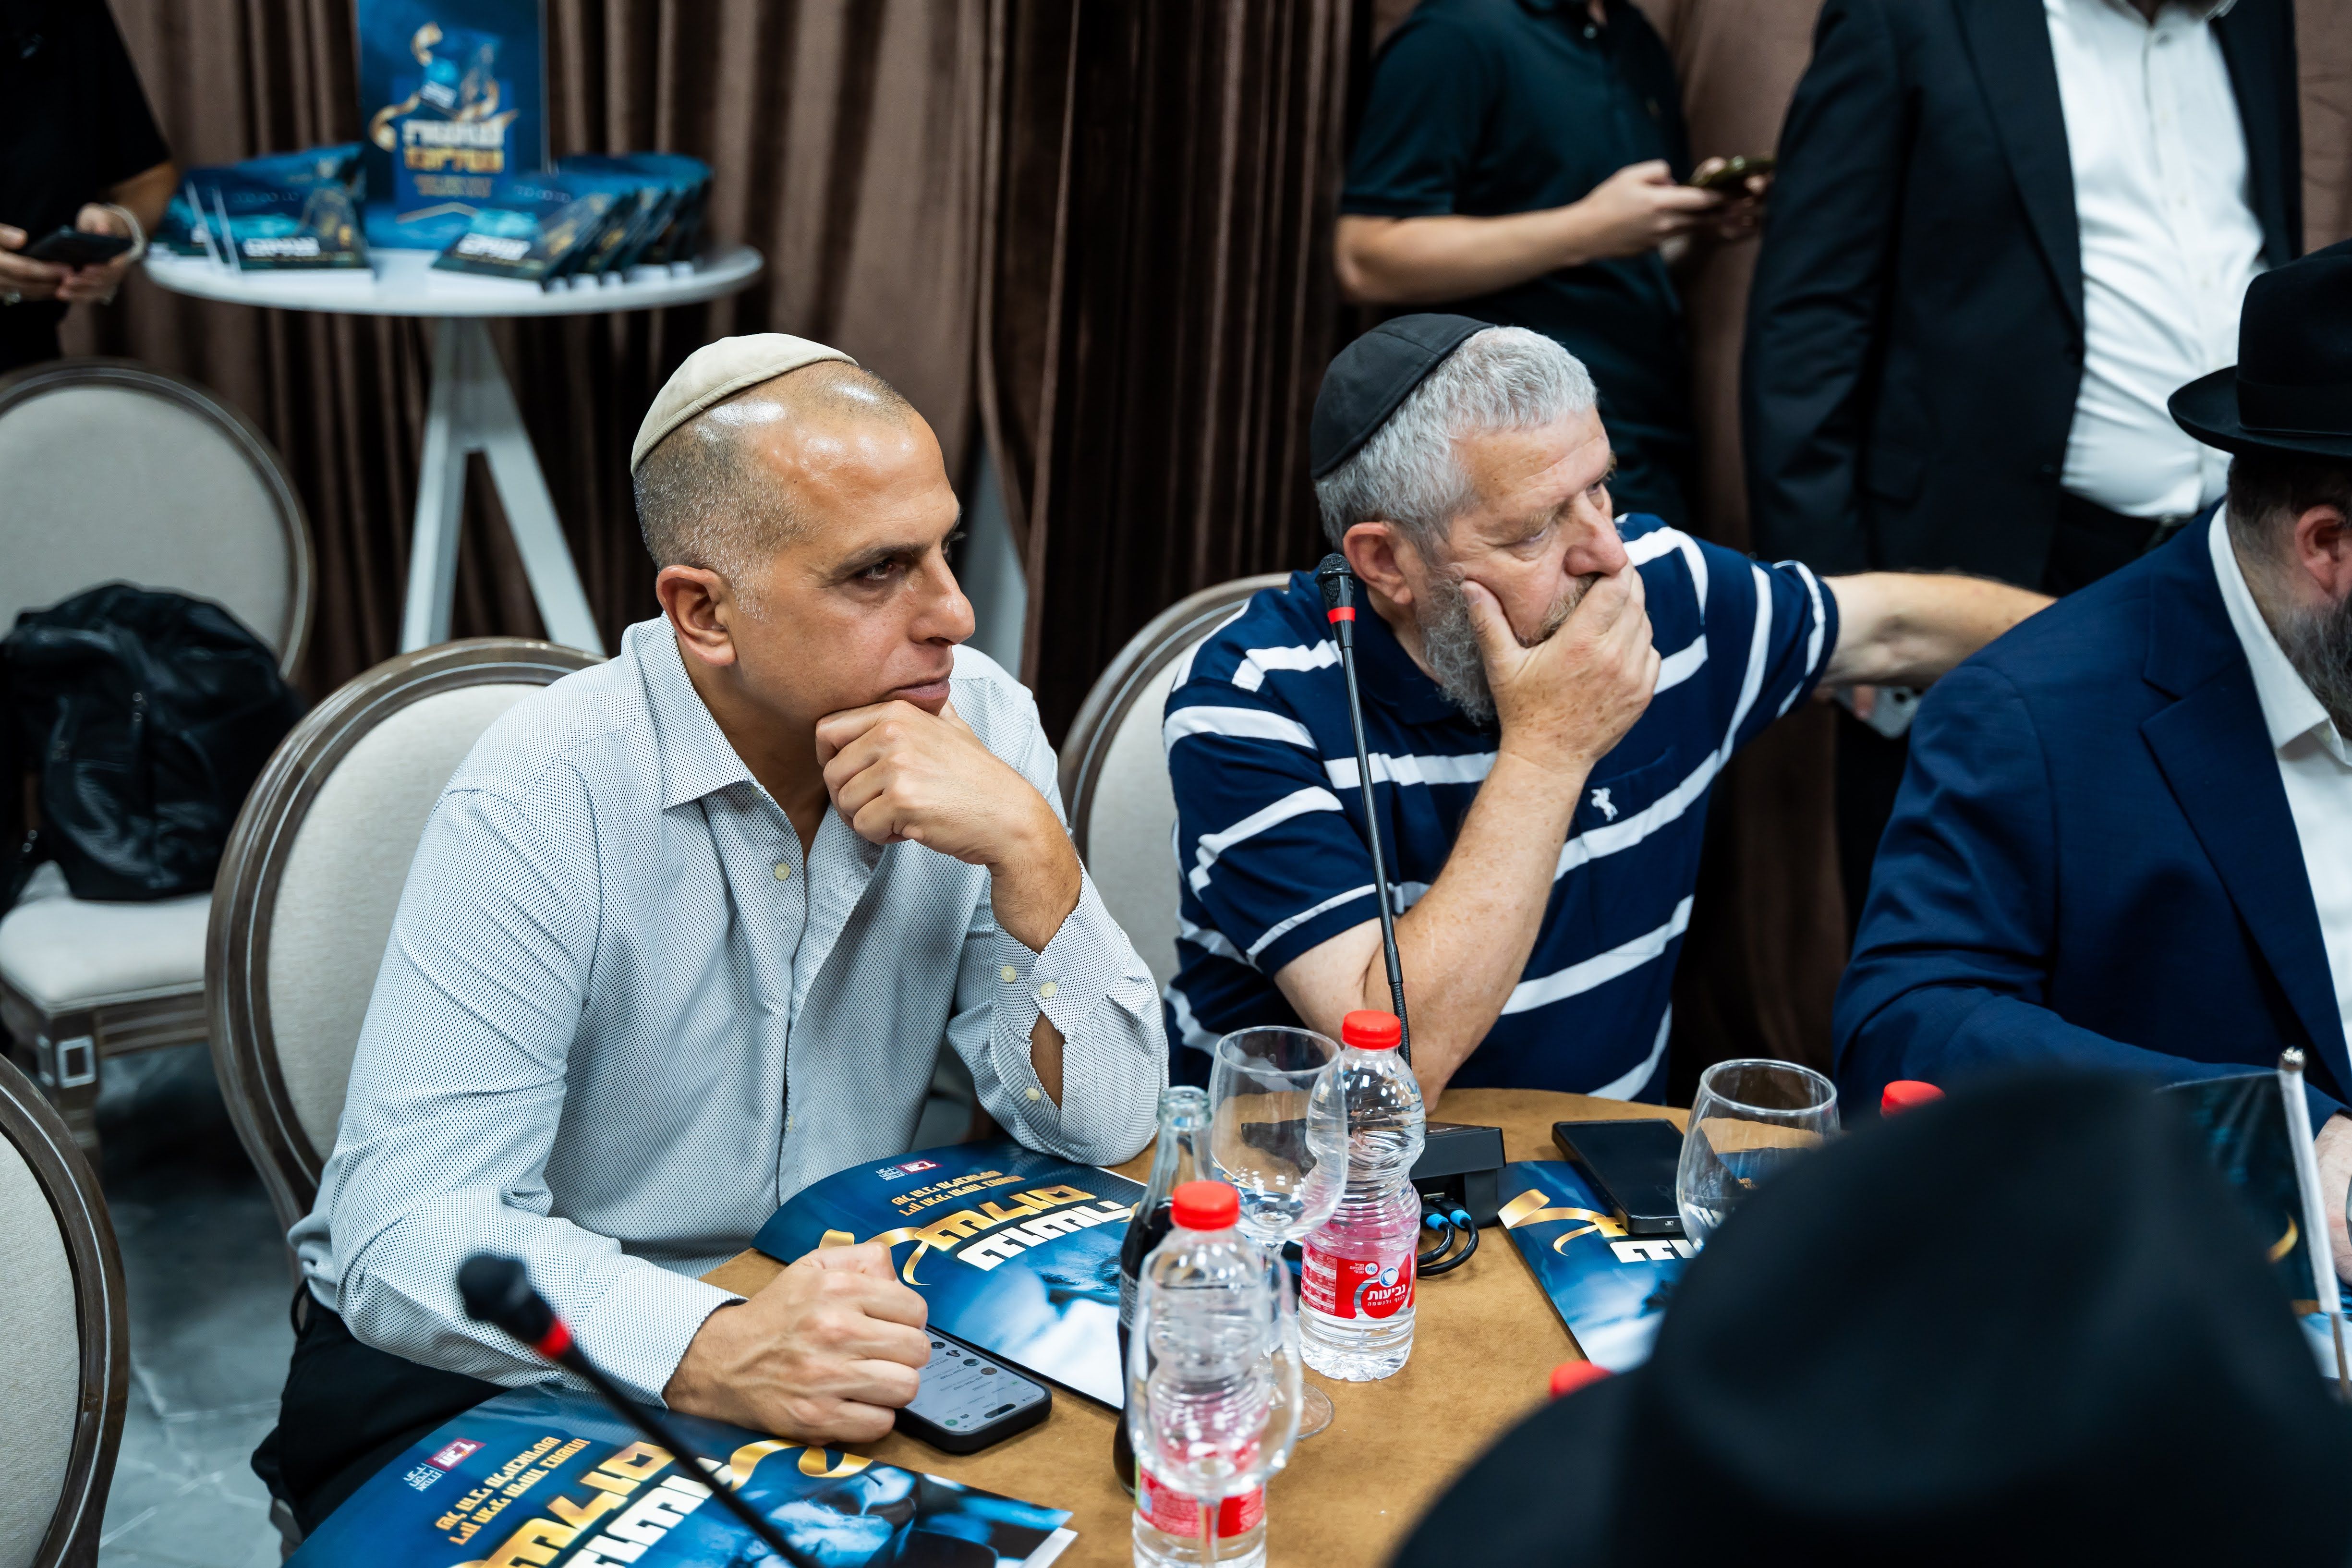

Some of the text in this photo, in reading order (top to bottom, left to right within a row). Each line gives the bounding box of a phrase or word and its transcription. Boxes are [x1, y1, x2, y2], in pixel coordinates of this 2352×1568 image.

[891, 1194, 916, 1205] של
[909, 1186, 940, 1197] הרבי
[898, 1203, 925, 1216] דיון
[920, 1194, 953, 1206] חגיגי
[947, 1184, 987, 1197] ומיוחד
[914, 1184, 1097, 1252] שלום
[957, 1200, 1132, 1271] עושה
[1367, 1284, 1406, 1301] נביעות
[1394, 1295, 1405, 1303] לגוף
[435, 1511, 467, 1530] של
[455, 1488, 494, 1512] הרבי
[484, 1436, 562, 1488] מליובאוויטש
[449, 1438, 591, 1545] דיון חגיגי ומיוחד במשנתו
